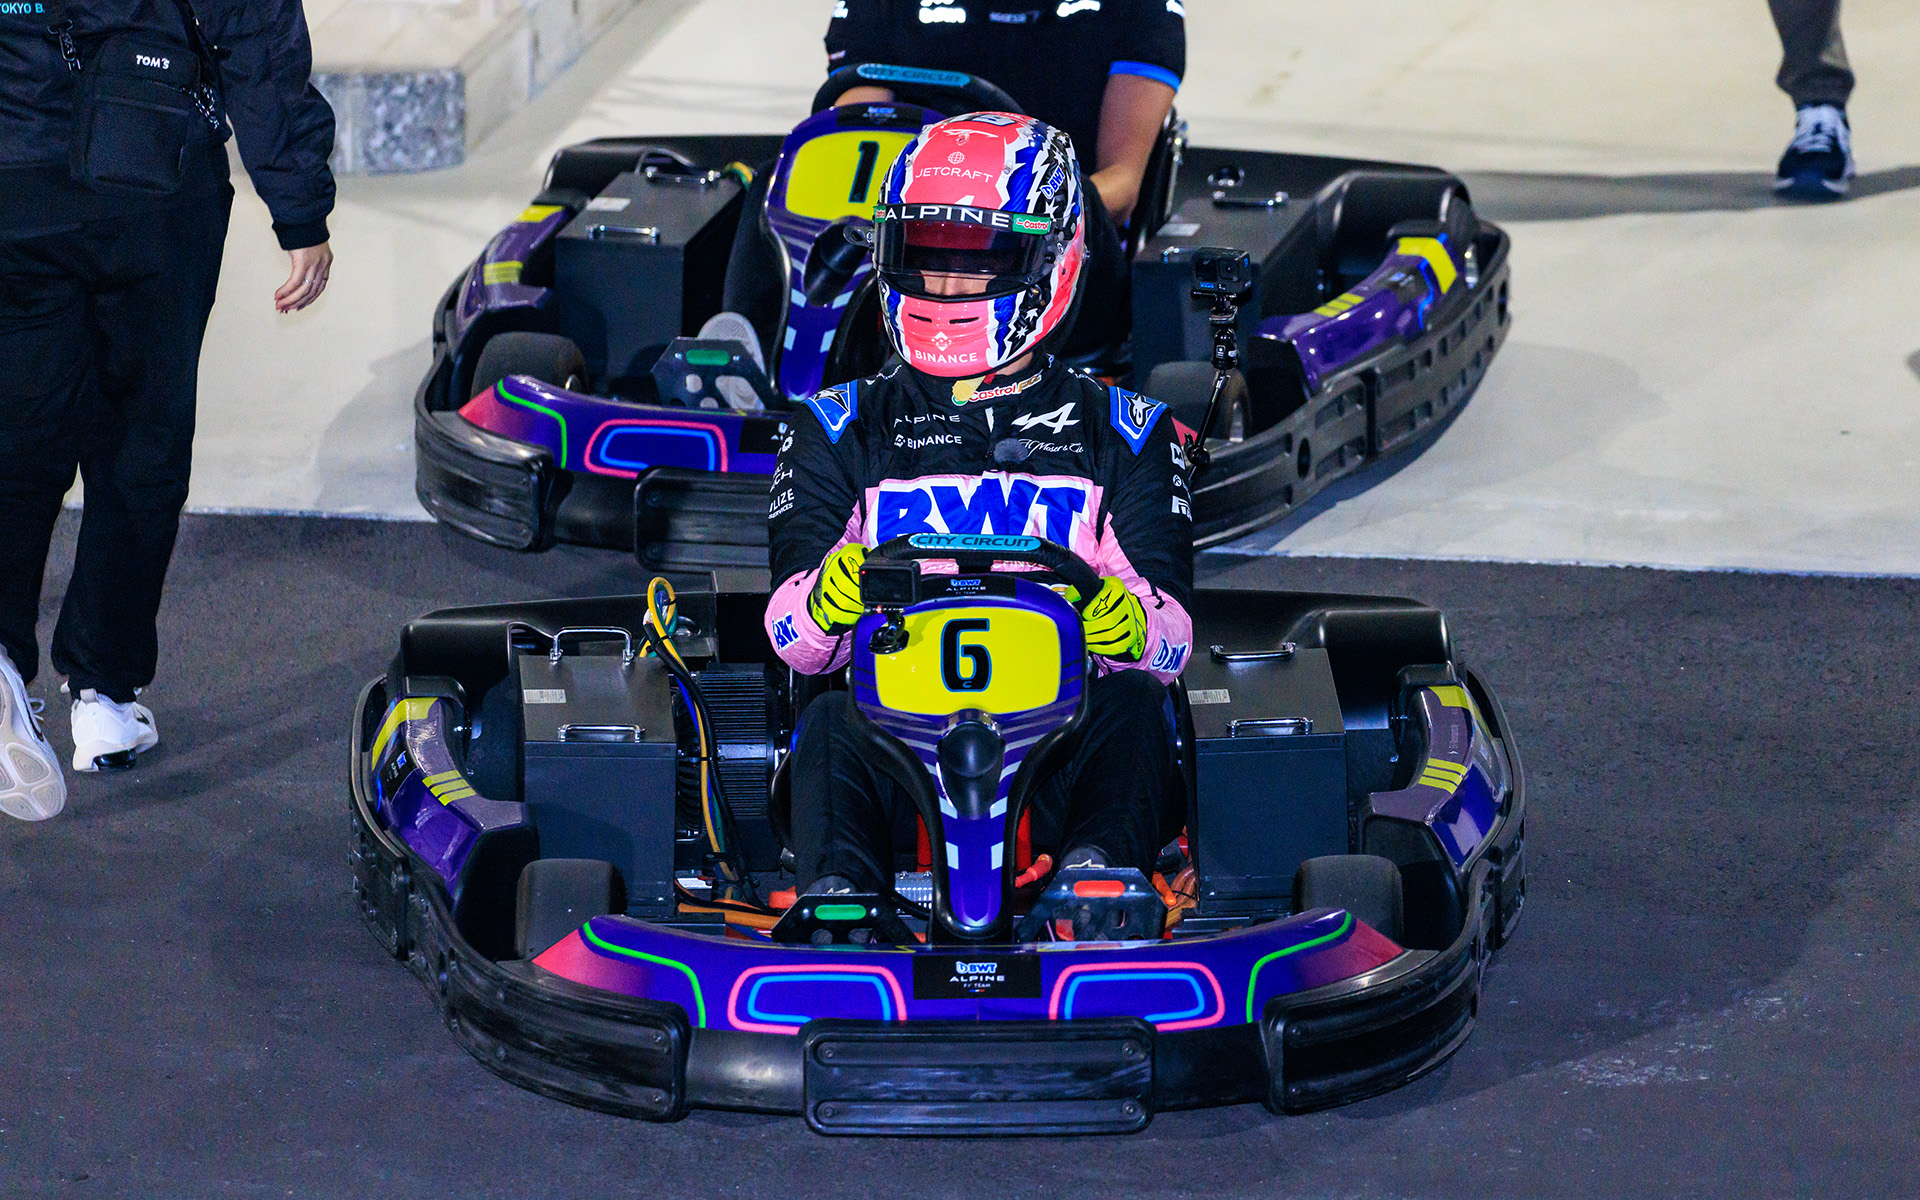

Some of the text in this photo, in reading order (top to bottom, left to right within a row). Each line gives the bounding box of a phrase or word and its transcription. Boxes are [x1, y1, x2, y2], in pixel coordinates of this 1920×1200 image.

[136, 54, 170, 70] TOM'S
[848, 141, 880, 203] 1
[915, 166, 994, 183] JETCRAFT
[1047, 165, 1066, 193] BWT
[885, 205, 1010, 228] ALPINE
[1023, 219, 1050, 231] Castrol
[915, 350, 978, 364] BINANCE
[893, 413, 960, 429] ALPINE
[907, 434, 962, 450] BINANCE
[877, 478, 1086, 550] BWT
[916, 535, 1034, 547] CITY CIRCUIT
[940, 618, 993, 693] 6
[967, 962, 997, 974] BWT
[949, 975, 1005, 983] ALPINE
